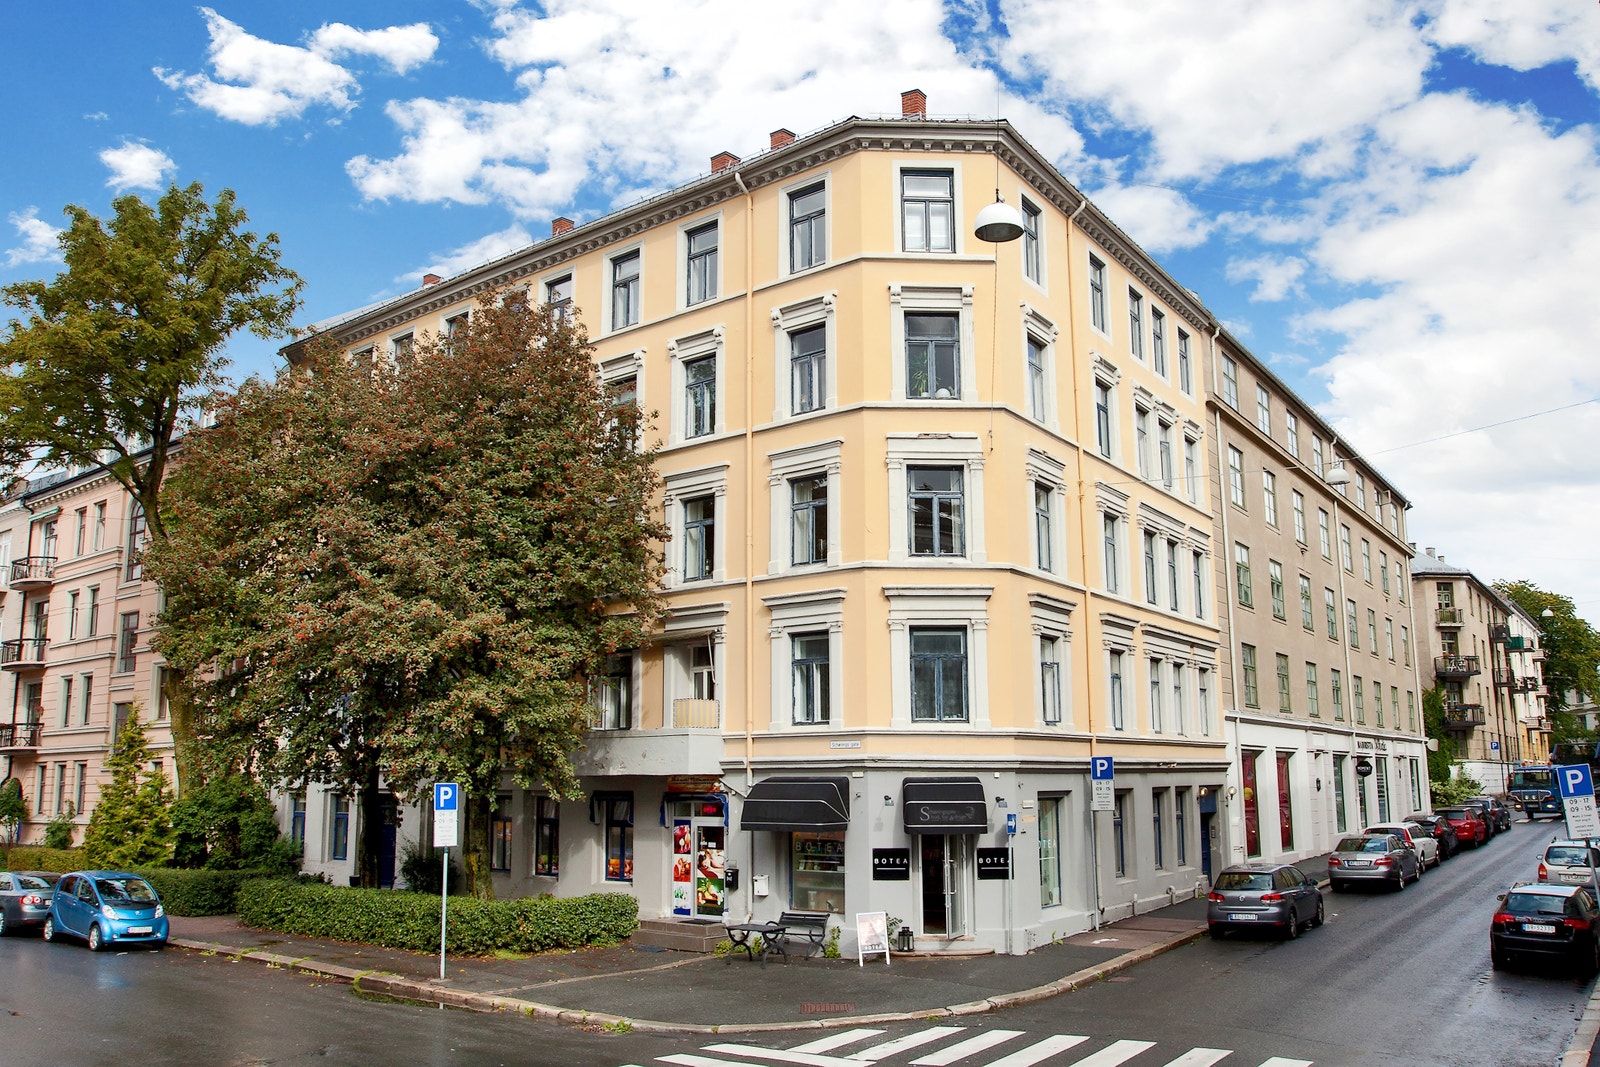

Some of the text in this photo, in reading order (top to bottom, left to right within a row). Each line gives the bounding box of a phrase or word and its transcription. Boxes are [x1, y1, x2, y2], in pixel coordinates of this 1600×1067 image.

[1096, 760, 1108, 777] P
[1565, 770, 1584, 794] P
[440, 786, 452, 808] P
[795, 841, 843, 853] BOTEA
